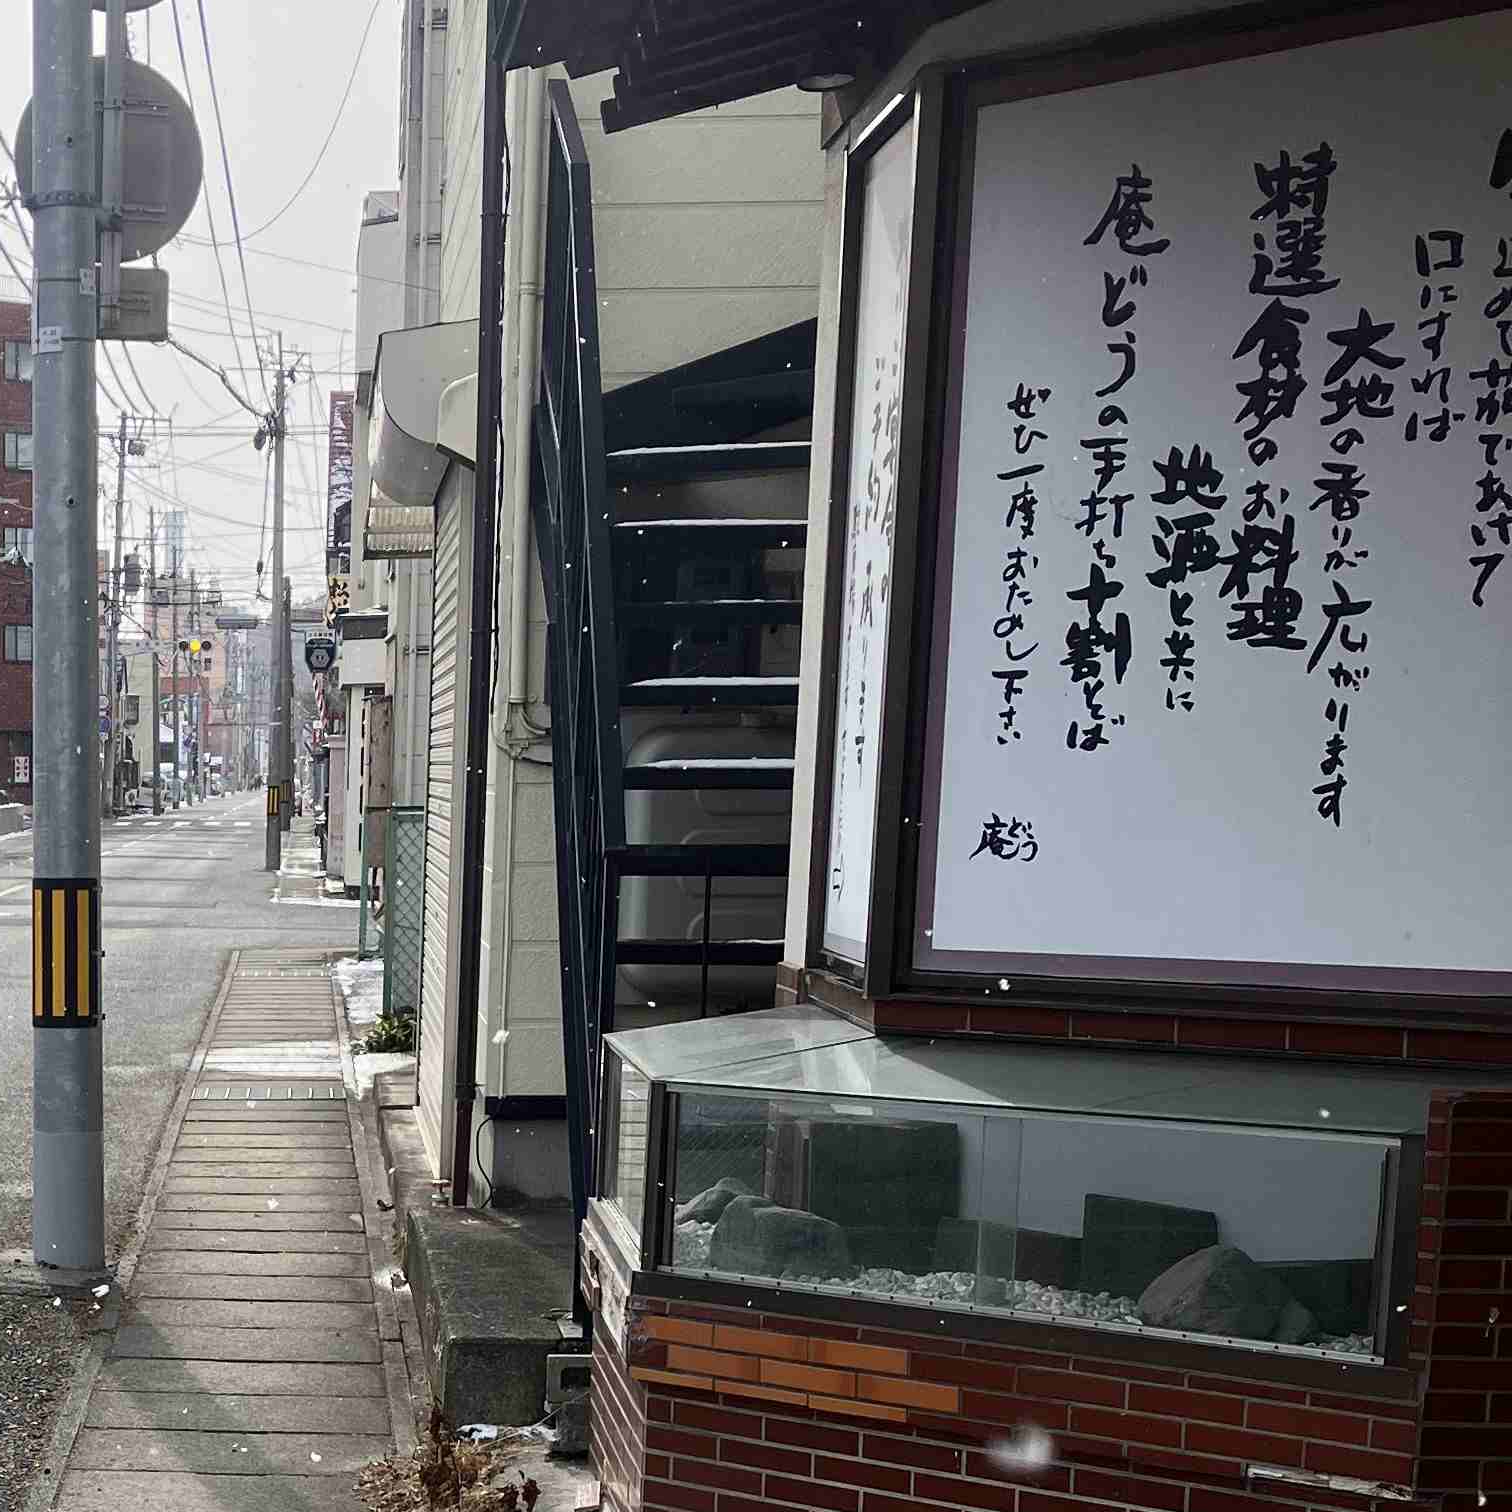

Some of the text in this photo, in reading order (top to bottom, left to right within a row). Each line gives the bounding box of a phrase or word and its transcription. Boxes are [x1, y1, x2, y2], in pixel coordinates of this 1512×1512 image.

[1059, 164, 1171, 752] 庵どうの手打ち十割そば
[1405, 230, 1465, 443] 口にすれば
[991, 382, 1051, 745] ぜひ一度おためし下さい
[1145, 443, 1227, 712] 地酒と共に
[1306, 307, 1405, 827] 大地の香りが広がります
